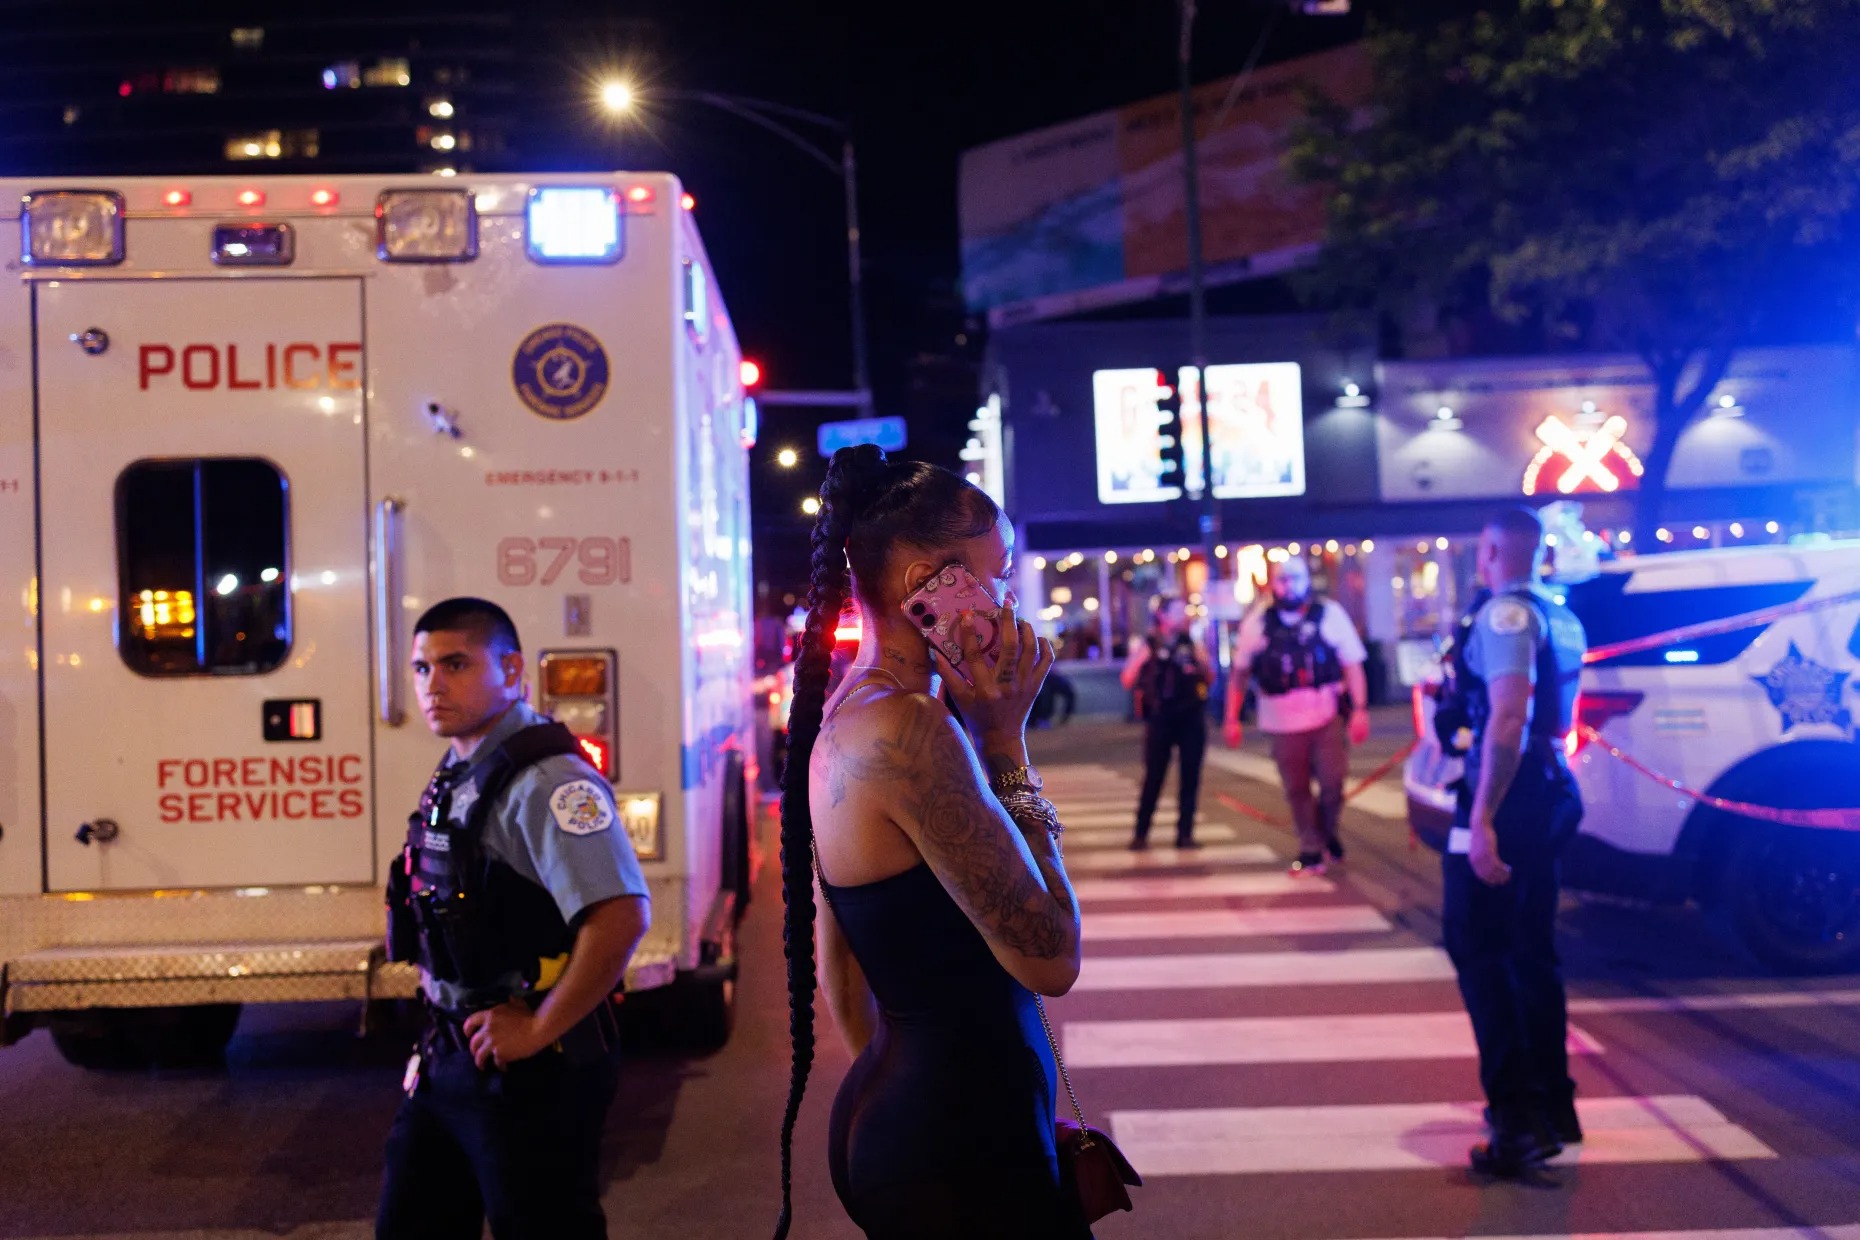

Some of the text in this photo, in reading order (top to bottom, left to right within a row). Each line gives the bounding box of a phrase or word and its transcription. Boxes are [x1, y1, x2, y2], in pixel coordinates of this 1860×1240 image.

[139, 342, 362, 391] POLICE
[497, 536, 632, 588] 6791
[157, 753, 363, 789] FORENSIC
[159, 788, 364, 824] SERVICES
[557, 784, 603, 811] CHICAGO
